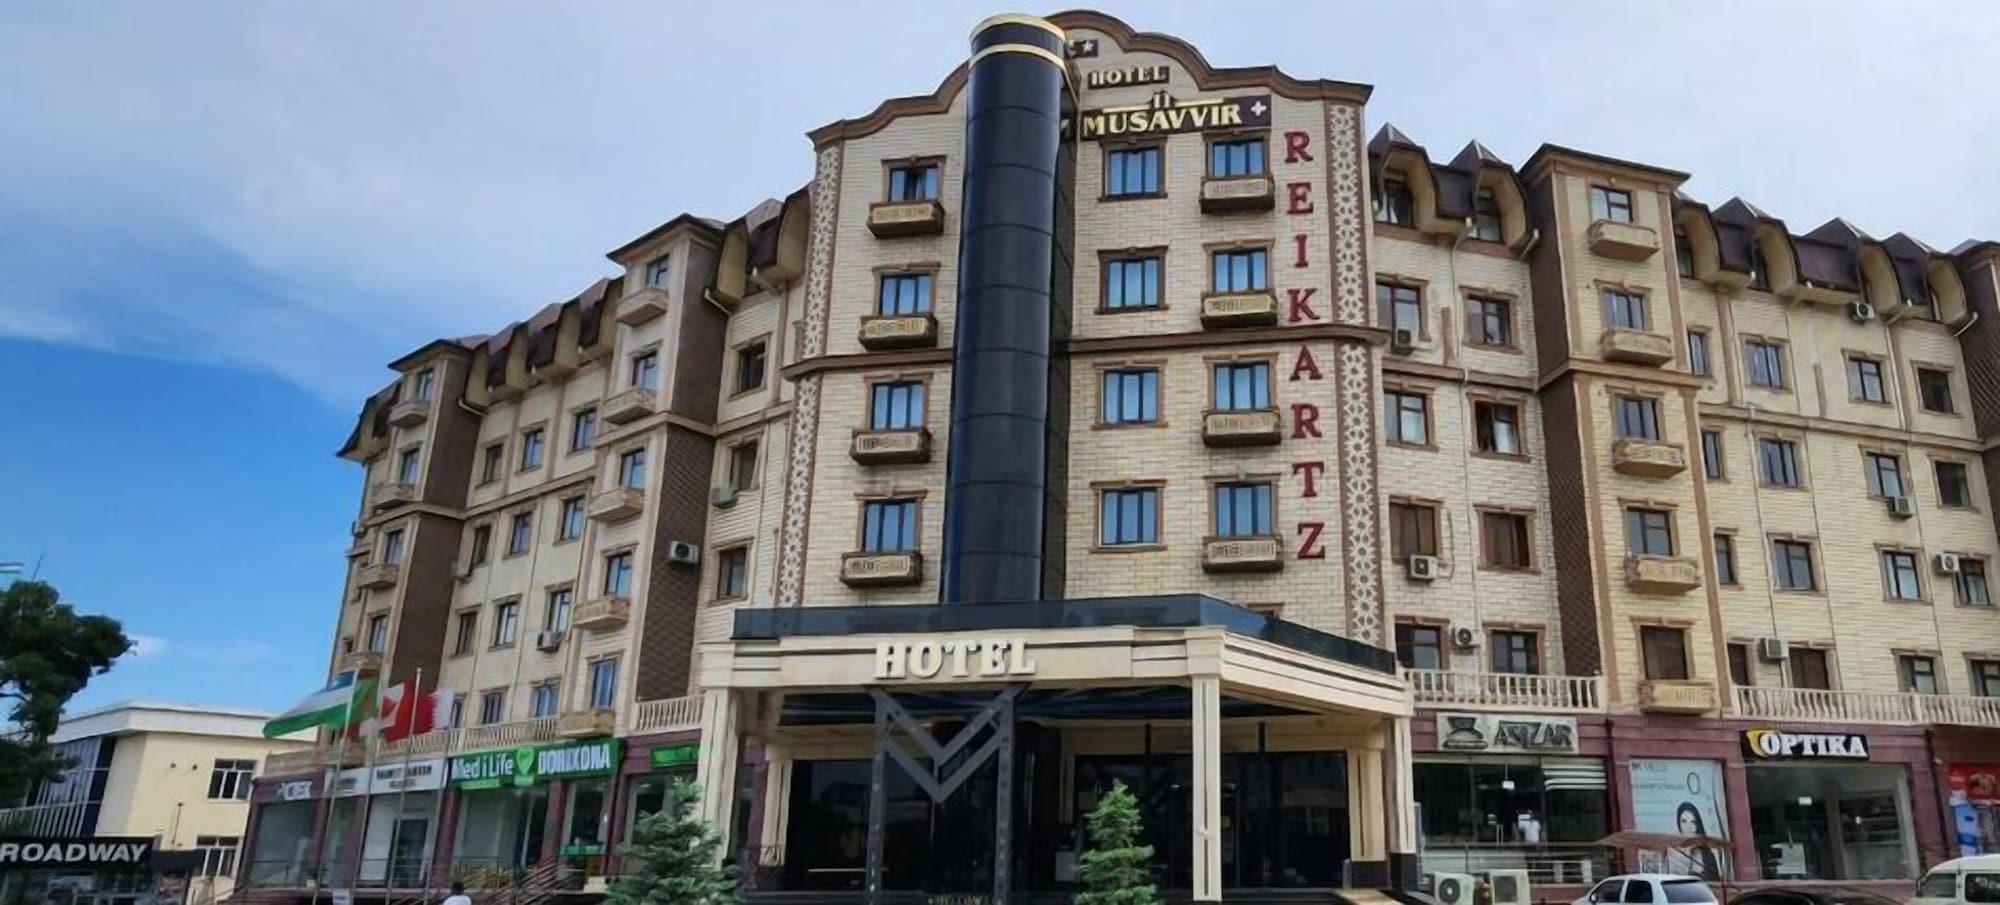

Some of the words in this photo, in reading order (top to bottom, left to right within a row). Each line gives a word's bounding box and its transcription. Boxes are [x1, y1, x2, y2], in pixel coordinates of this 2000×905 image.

[1091, 67, 1165, 86] HOTEL
[1083, 104, 1242, 136] MUSAVVIR
[1284, 131, 1326, 559] REIKARTZ
[874, 639, 1037, 679] HOTEL
[1760, 733, 1868, 757] OPTIKA
